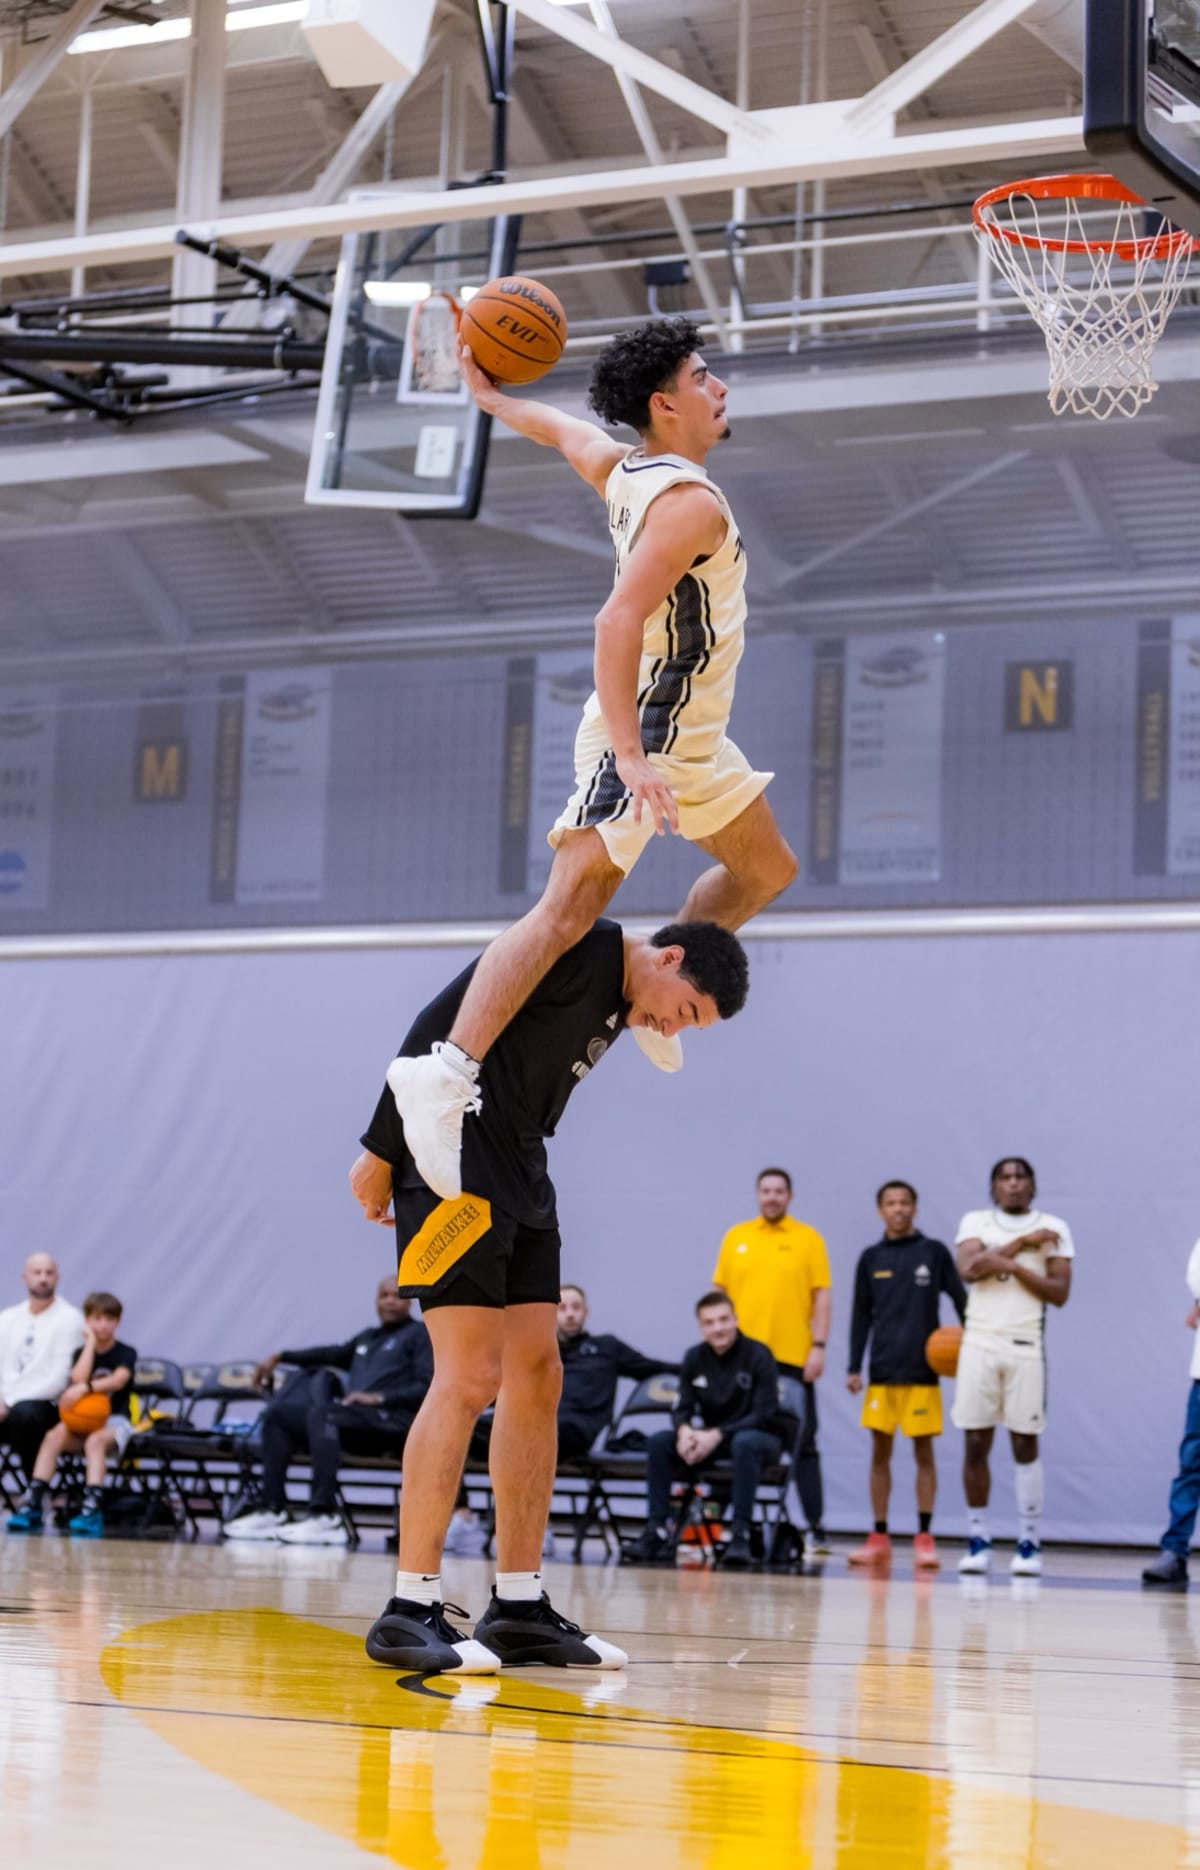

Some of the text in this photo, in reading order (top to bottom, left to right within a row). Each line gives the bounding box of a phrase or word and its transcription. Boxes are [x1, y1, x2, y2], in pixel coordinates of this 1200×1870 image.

[500, 282, 560, 328] Wilson
[1020, 667, 1057, 725] N
[143, 746, 178, 798] M
[416, 1203, 480, 1275] MILWAUKEE
